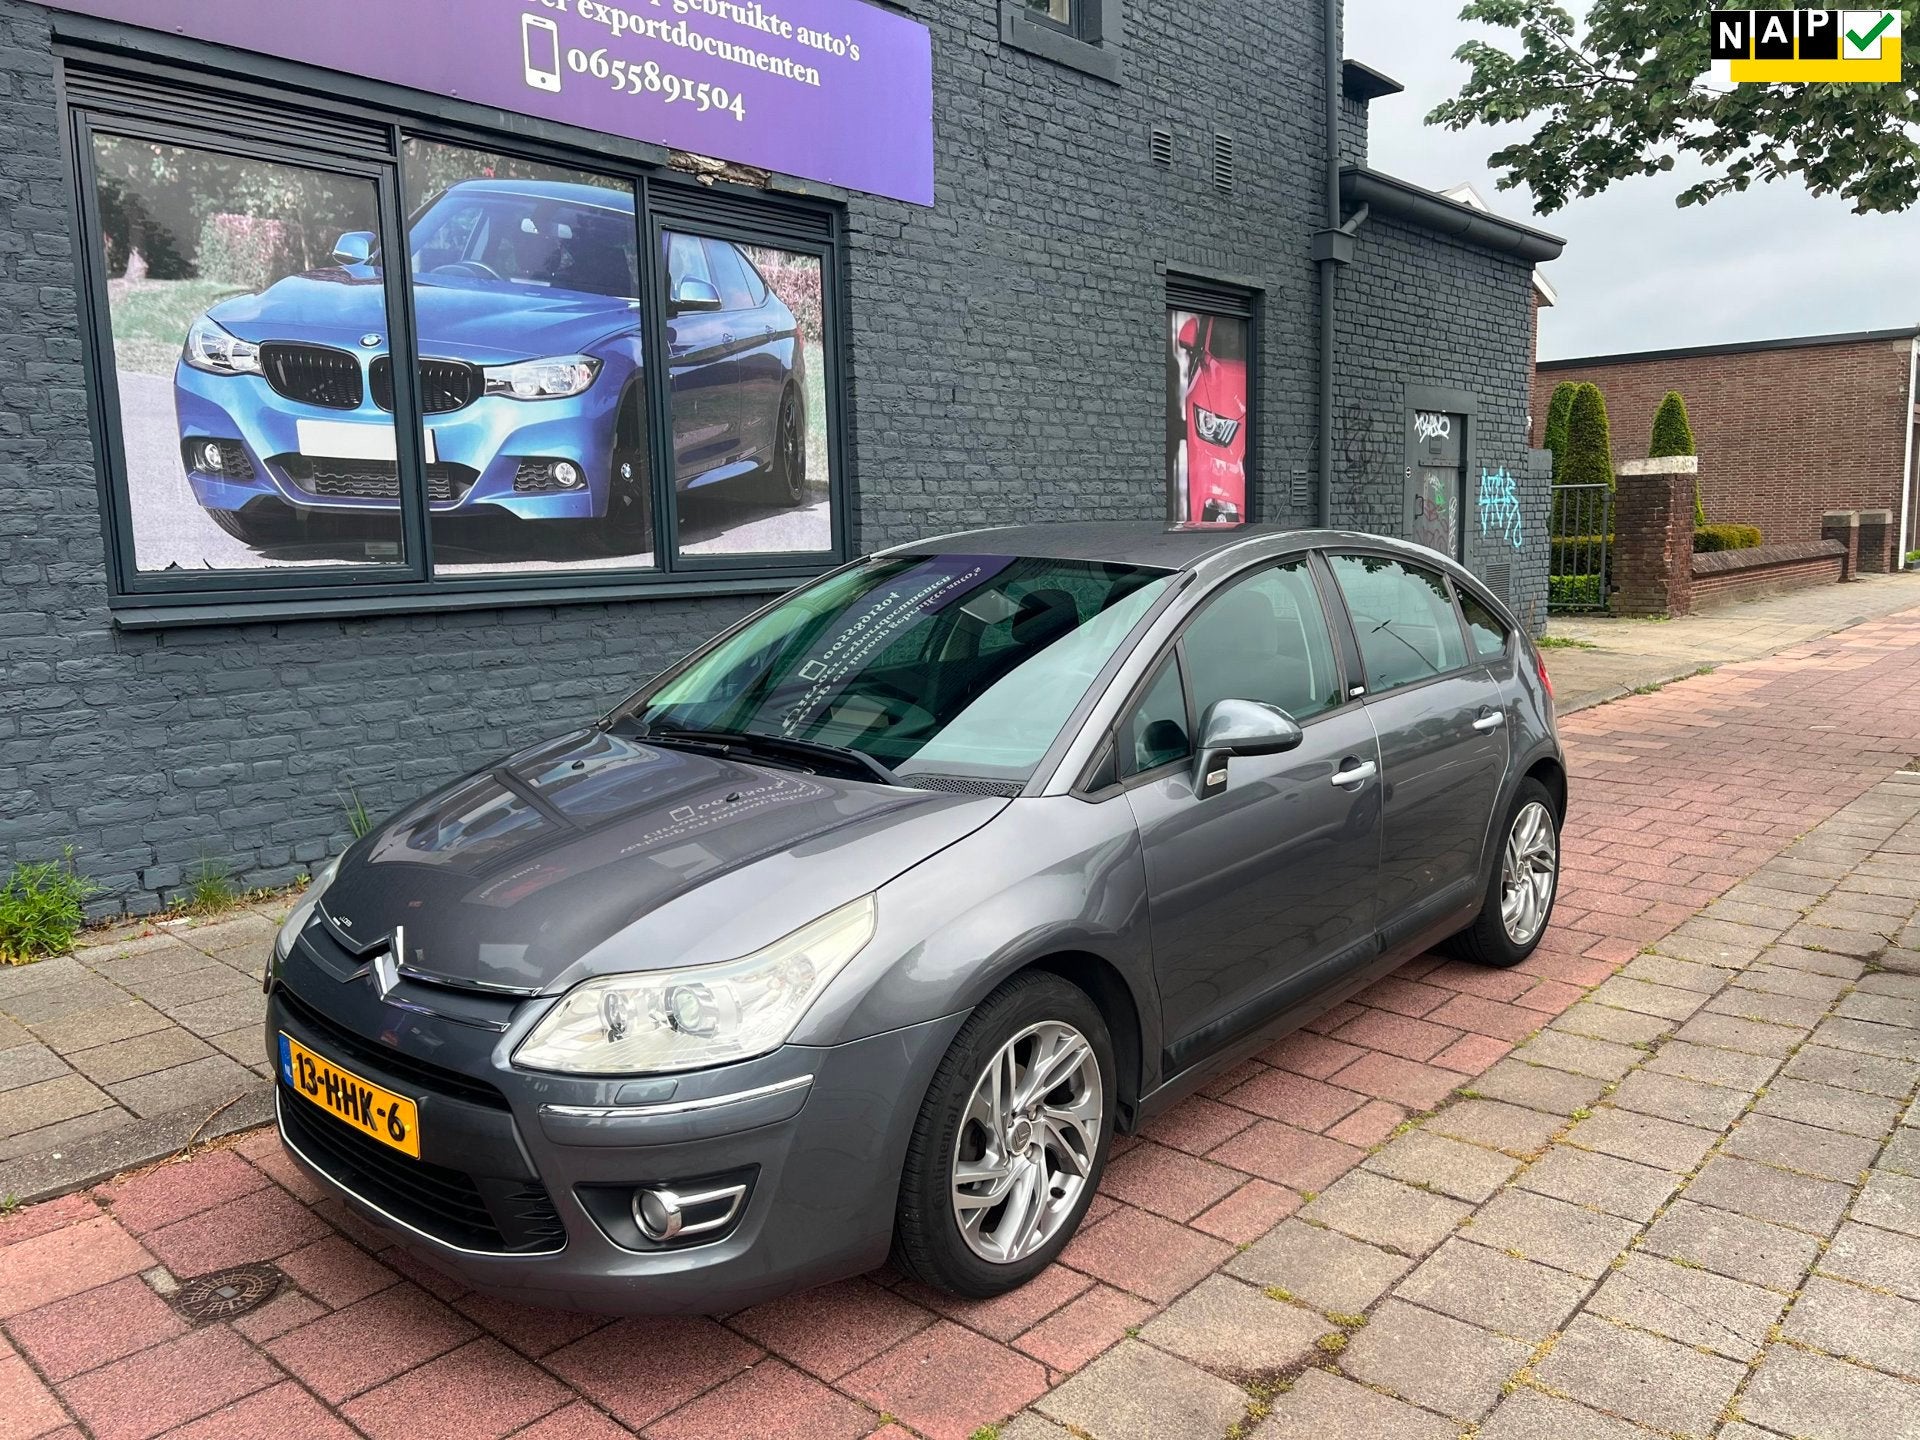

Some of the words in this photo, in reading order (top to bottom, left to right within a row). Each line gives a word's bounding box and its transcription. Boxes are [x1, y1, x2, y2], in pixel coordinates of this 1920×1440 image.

[567, 49, 746, 121] 0655891504
[577, 0, 821, 86] exportdocumenten
[295, 1052, 406, 1142] 13-HHK-6
